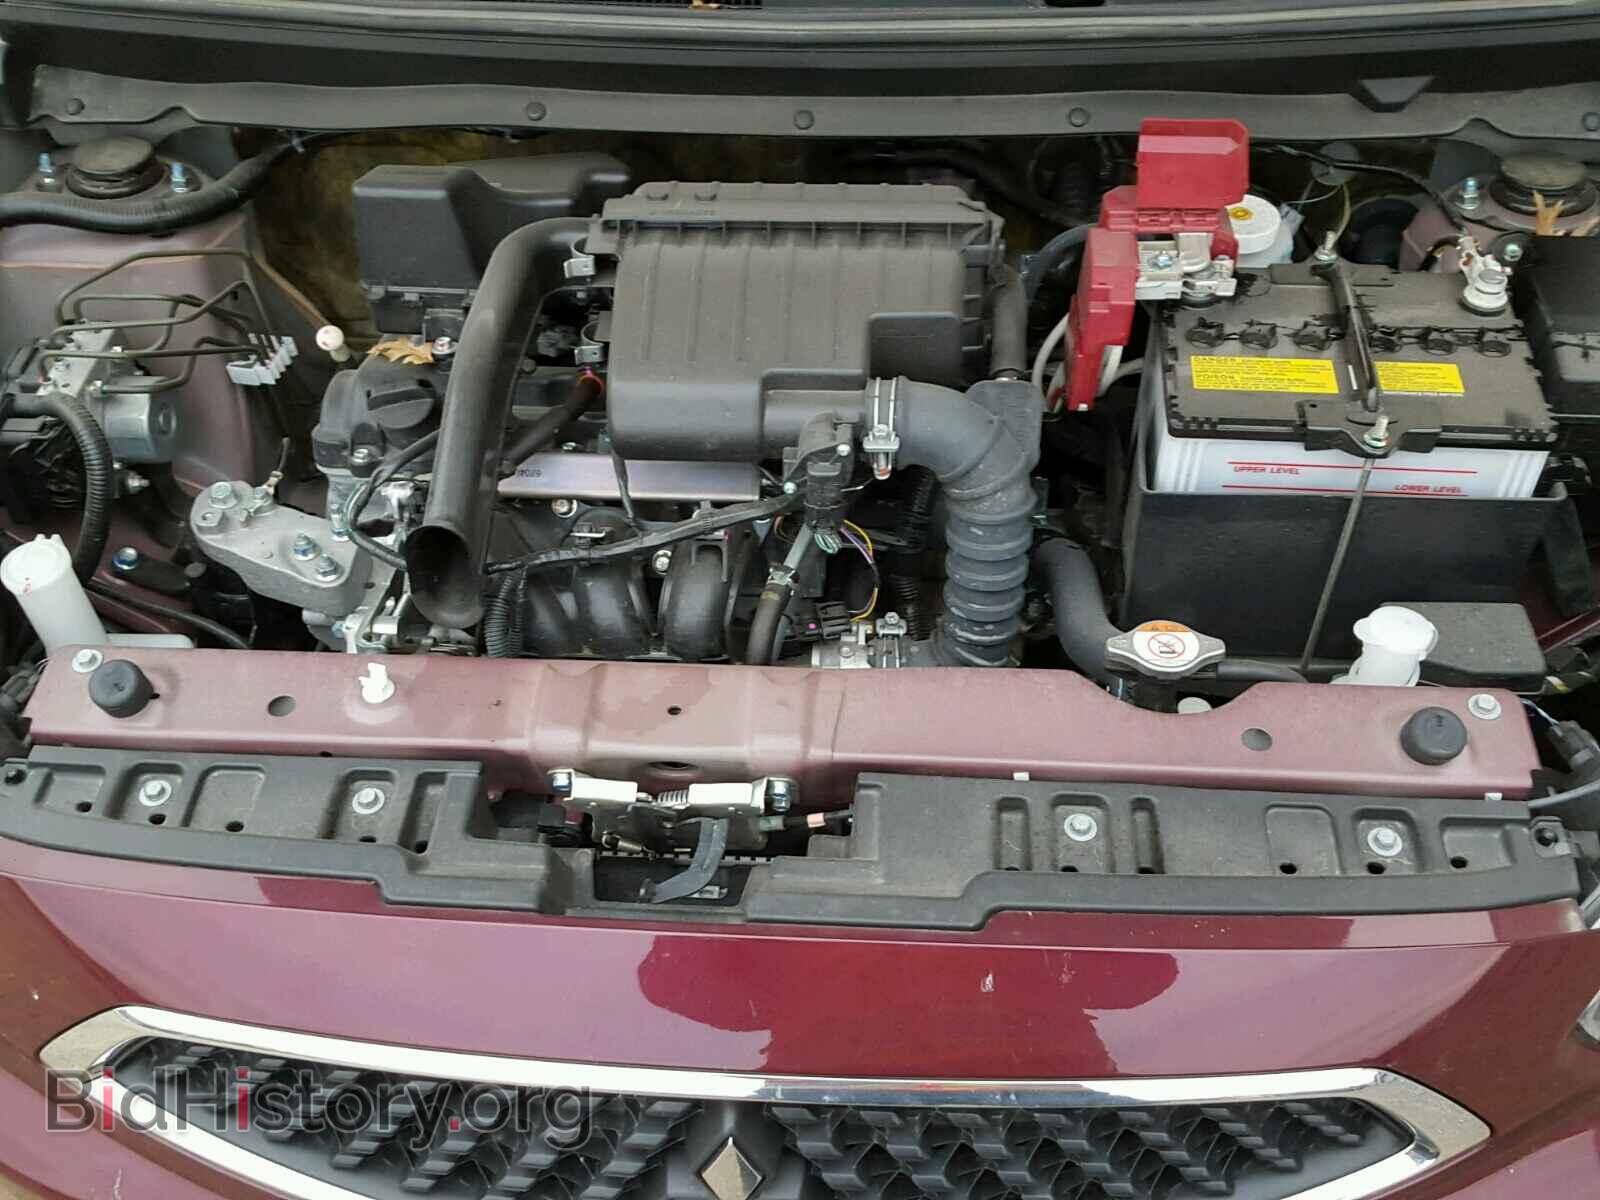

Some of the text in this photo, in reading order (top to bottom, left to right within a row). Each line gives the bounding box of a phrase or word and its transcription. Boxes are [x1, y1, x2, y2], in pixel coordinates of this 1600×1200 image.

[1233, 465, 1300, 475] UPPER LEVEL
[1395, 484, 1462, 494] LOWER LEVEL
